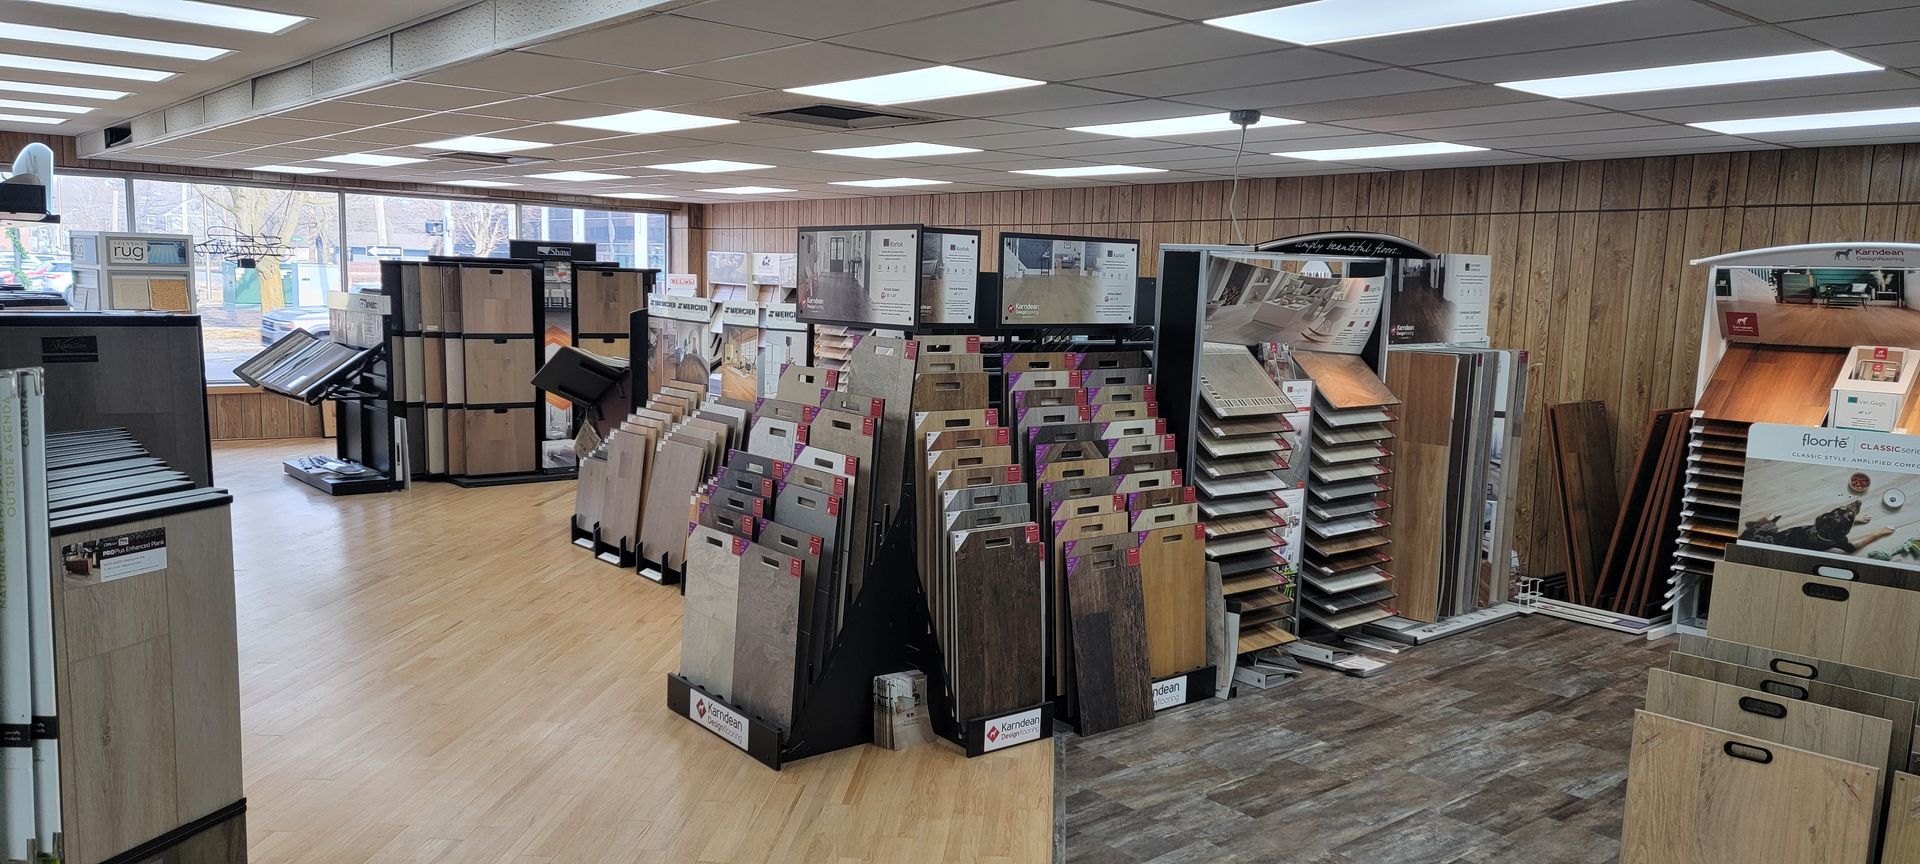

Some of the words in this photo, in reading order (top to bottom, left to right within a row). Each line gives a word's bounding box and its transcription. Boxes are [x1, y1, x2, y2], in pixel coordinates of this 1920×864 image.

[114, 246, 144, 261] rug
[550, 247, 571, 256] Shaw
[1326, 240, 1370, 256] beautiful
[1855, 248, 1904, 256] Karndean
[682, 303, 708, 311] MERCIER
[730, 306, 756, 315] MERCIER
[1871, 400, 1886, 408] Gogh
[2, 393, 14, 453] AGENDA
[20, 390, 30, 448] CABANA
[1792, 451, 1822, 460] CLASSIC
[1851, 458, 1892, 466] AMPLIFIED
[4, 456, 16, 517] OUTSIDE
[102, 547, 125, 557] PROPlus
[126, 543, 151, 553] Enhanced
[151, 540, 165, 548] Plank
[707, 701, 743, 731] Karndean
[707, 715, 743, 744] Designflooring
[1001, 716, 1040, 732] Karndean
[1001, 726, 1040, 740] Designflooring
